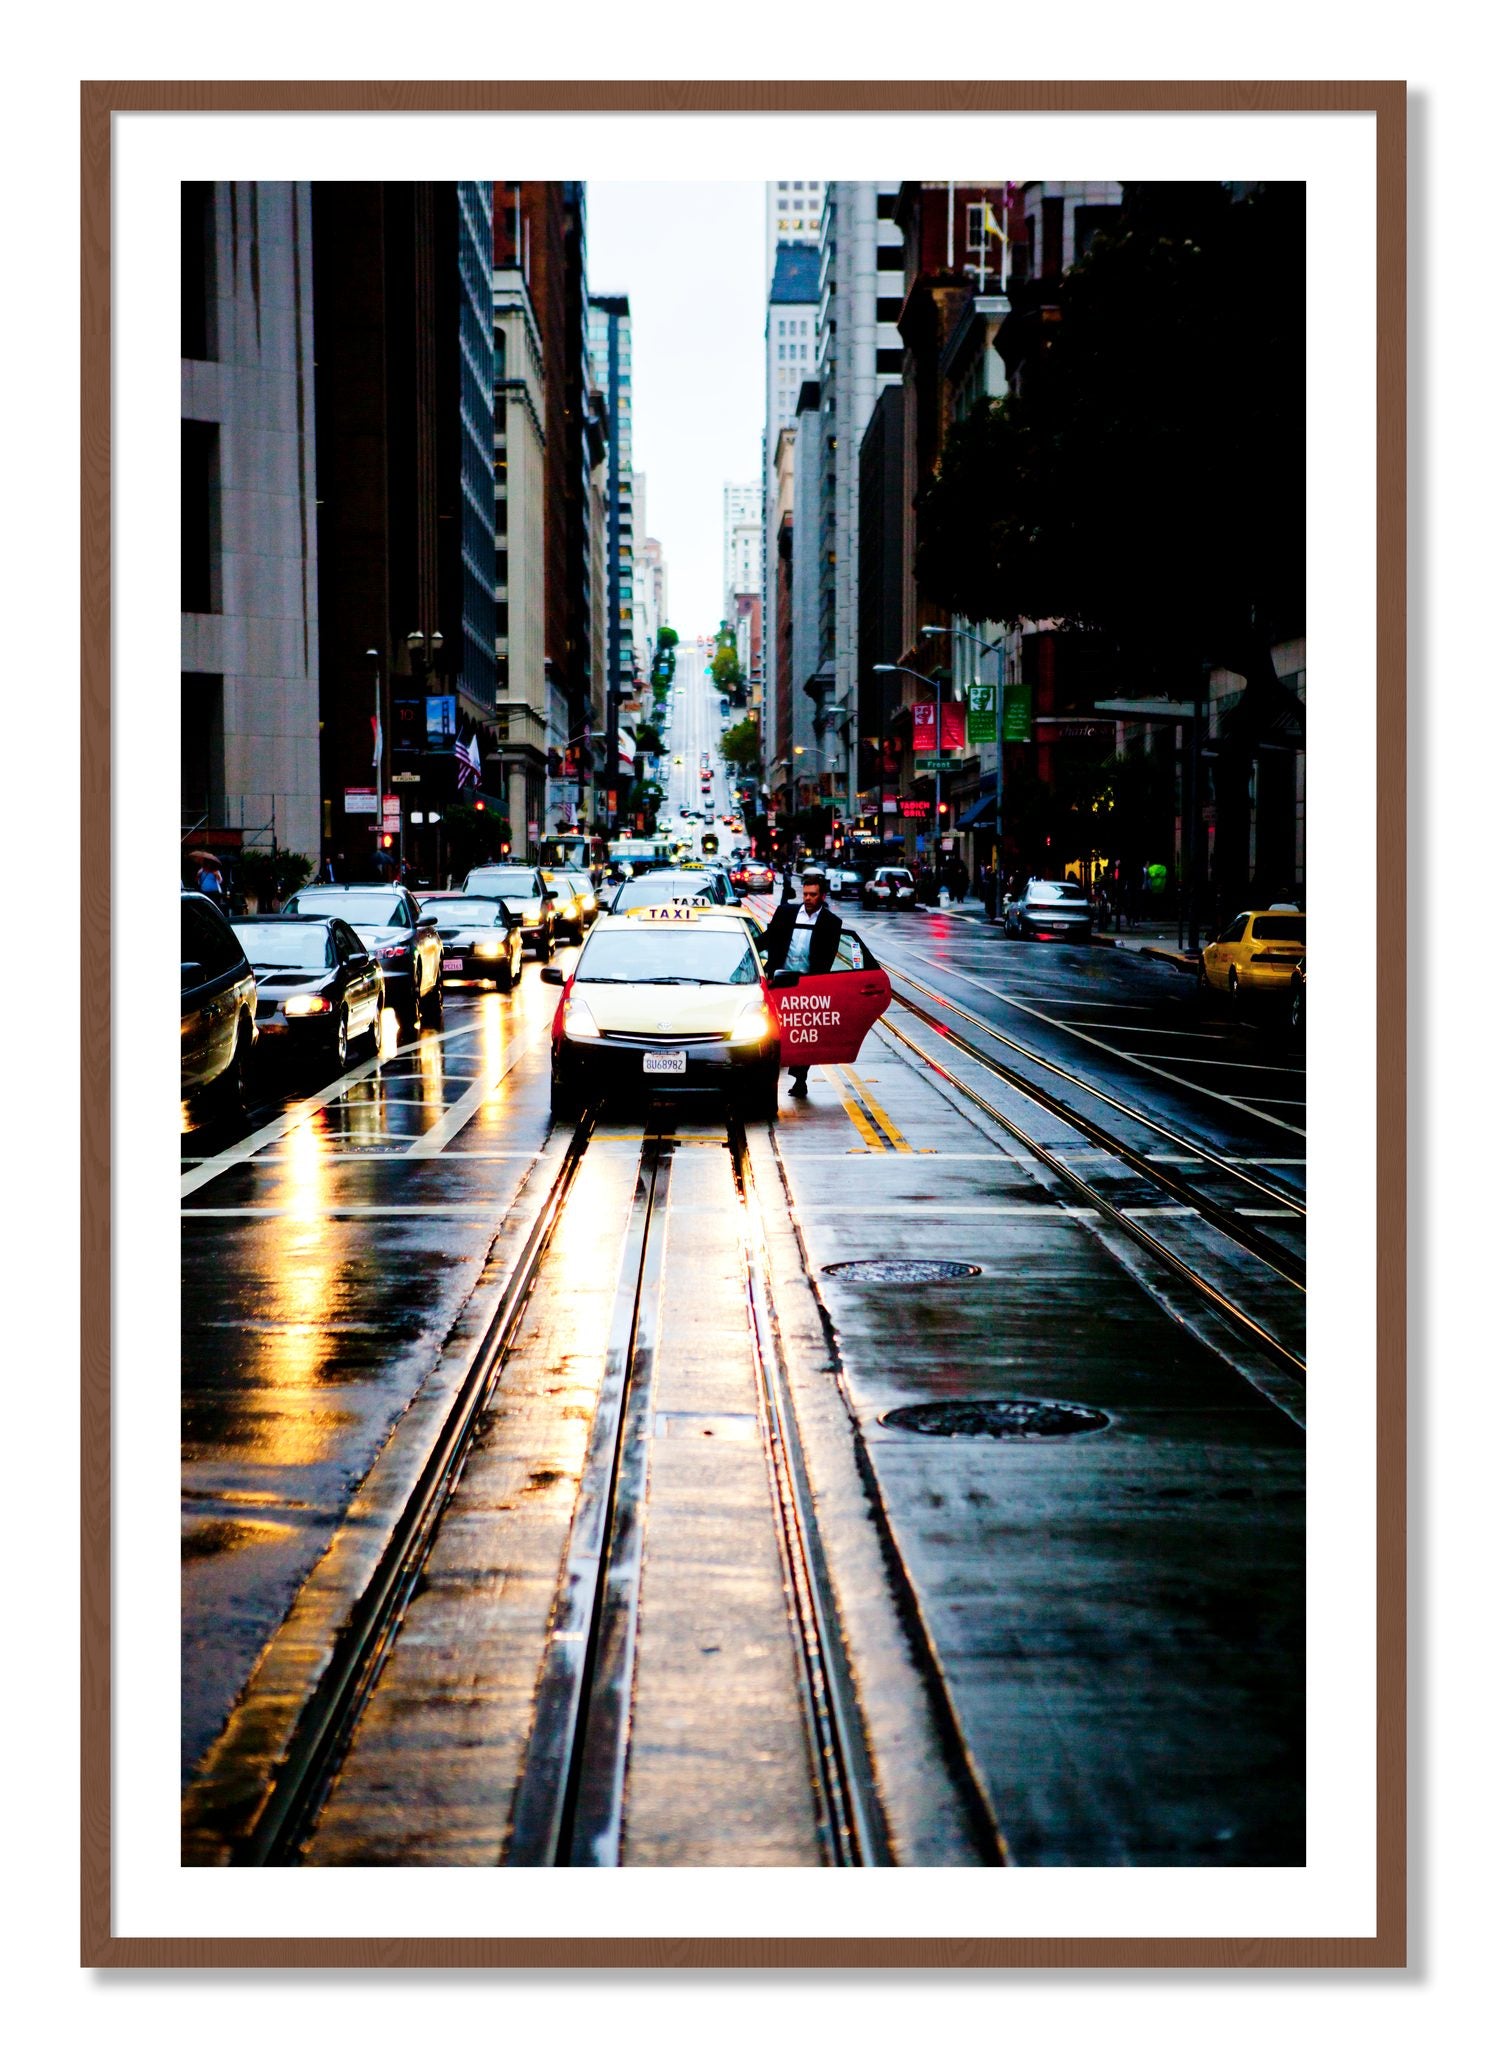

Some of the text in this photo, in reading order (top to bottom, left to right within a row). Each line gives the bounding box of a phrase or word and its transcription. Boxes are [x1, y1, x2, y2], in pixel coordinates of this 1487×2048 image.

[900, 802, 930, 810] TADICH
[903, 810, 926, 818] GRILL
[672, 898, 706, 906] TAXI
[649, 909, 690, 919] TAXI
[780, 995, 831, 1010] ARROW
[789, 1029, 819, 1043] CAB
